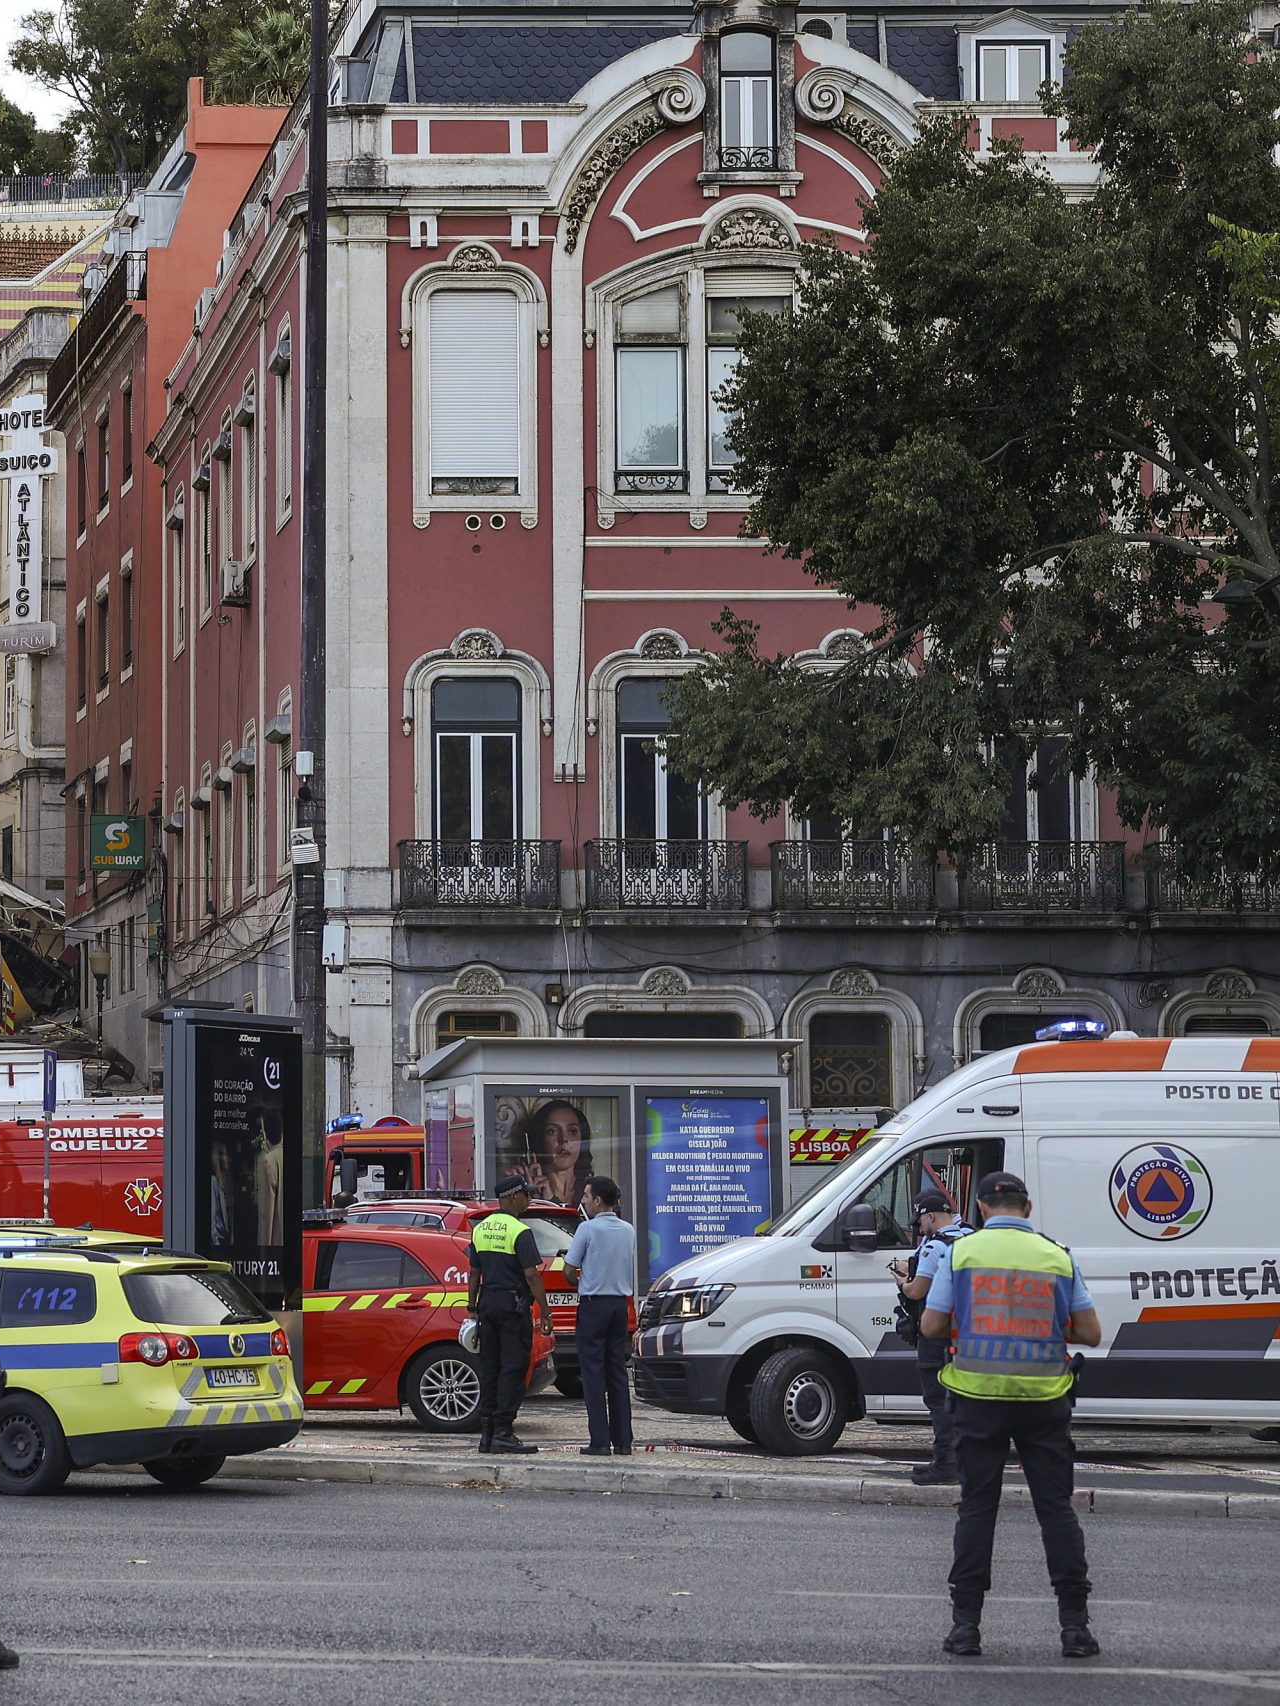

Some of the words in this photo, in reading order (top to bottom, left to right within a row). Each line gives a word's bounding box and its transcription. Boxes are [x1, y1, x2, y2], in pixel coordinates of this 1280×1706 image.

[15, 483, 31, 617] ATLÂNTICO
[1, 636, 46, 649] TURIM
[93, 855, 143, 865] SUBWAY
[238, 1034, 261, 1043] JCDecaux
[240, 1047, 247, 1056] 24
[214, 1080, 223, 1089] NO
[224, 1080, 254, 1093] CORAÇÃO
[1165, 1085, 1231, 1100] POSTO
[1237, 1086, 1263, 1100] DE
[214, 1093, 223, 1102] DO
[224, 1094, 247, 1104] BAIRRO
[214, 1109, 227, 1119] para
[699, 1125, 735, 1134] GUERREIRO
[50, 1139, 148, 1152] QUELUZ
[688, 1140, 710, 1149] GISELA
[711, 1138, 727, 1149] JOÃO
[800, 1142, 851, 1153] LISBOA
[651, 1152, 674, 1160] HELDER
[674, 1152, 707, 1160] MOUTINHO
[711, 1152, 731, 1160] PEDRO
[731, 1152, 763, 1160] MOUTINHO
[665, 1164, 676, 1173] EM
[677, 1164, 694, 1173] CASA
[725, 1164, 734, 1173] AO
[735, 1164, 751, 1173] VIVO
[1129, 1161, 1169, 1188] PROTEÇÃO
[1173, 1166, 1191, 1188] CIVIL
[671, 1184, 691, 1192] MARIA
[666, 1193, 693, 1202] ANTÓNIO
[655, 1205, 674, 1214] JORGE
[707, 1204, 722, 1214] JOSÉ
[722, 1205, 747, 1213] MANUEL
[747, 1205, 762, 1213] NETO
[1147, 1212, 1177, 1222] LISBOA
[478, 1221, 508, 1232] POLÍCIA
[694, 1222, 708, 1232] RÃO
[483, 1234, 507, 1242] municipal
[679, 1234, 704, 1243] MARCO
[228, 1260, 266, 1275] NTURY
[454, 1271, 469, 1284] 11
[799, 1283, 835, 1291] PCMM01
[974, 1270, 1054, 1298] POLÍCIA
[31, 1287, 77, 1311] 112
[871, 1316, 893, 1326] 1594
[975, 1312, 1051, 1337] TRÂNSITO
